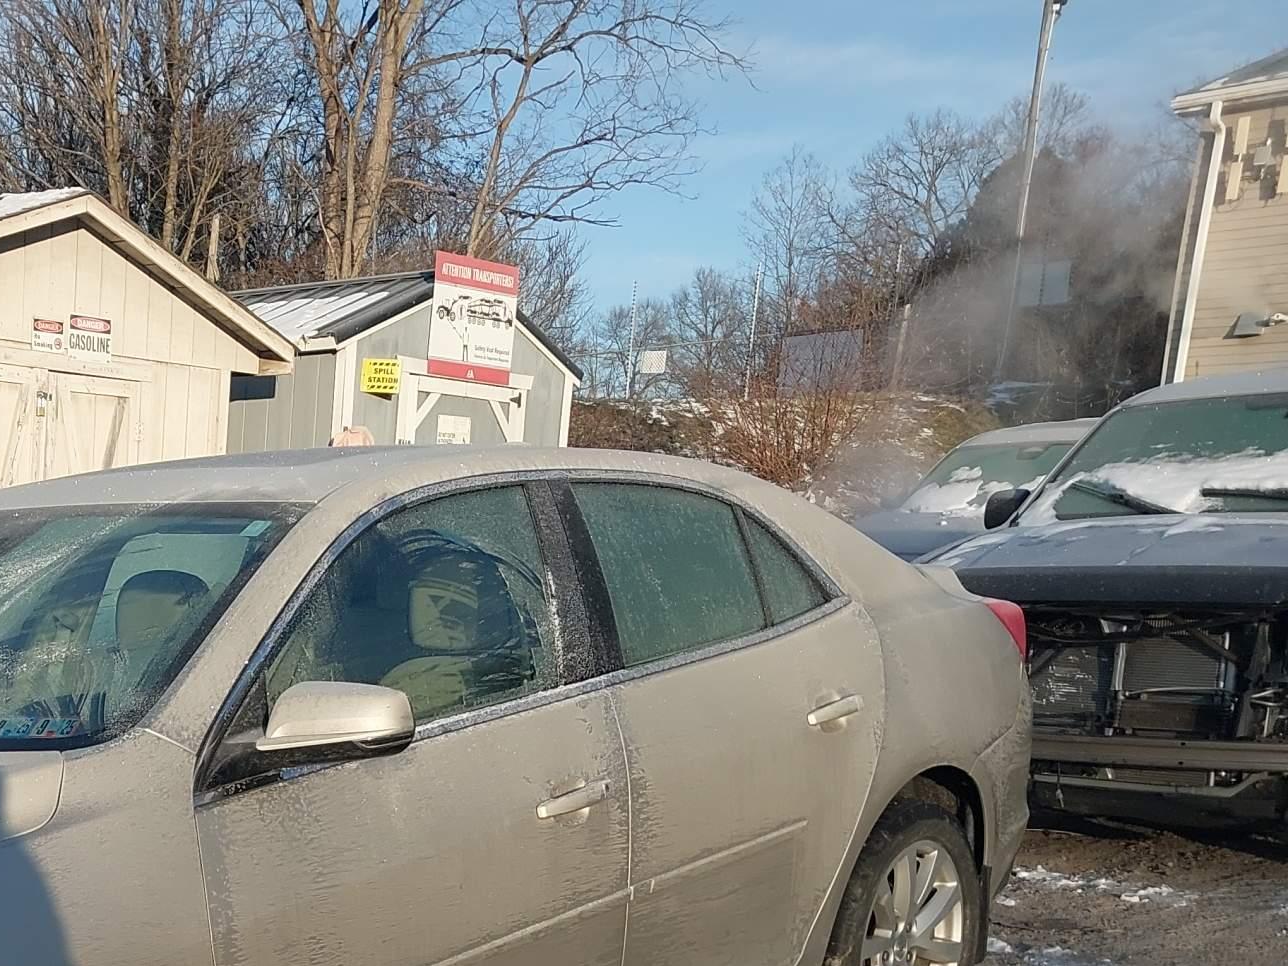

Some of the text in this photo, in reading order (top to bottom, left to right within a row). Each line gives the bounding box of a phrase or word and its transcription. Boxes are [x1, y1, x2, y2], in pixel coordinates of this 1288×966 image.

[441, 262, 514, 288] ATTENTION TRANSPORTERS!
[77, 320, 105, 331] DANGER
[34, 340, 53, 350] Smoking
[69, 333, 111, 354] GASOLINE
[374, 367, 395, 375] SPILL
[367, 376, 399, 385] STATION
